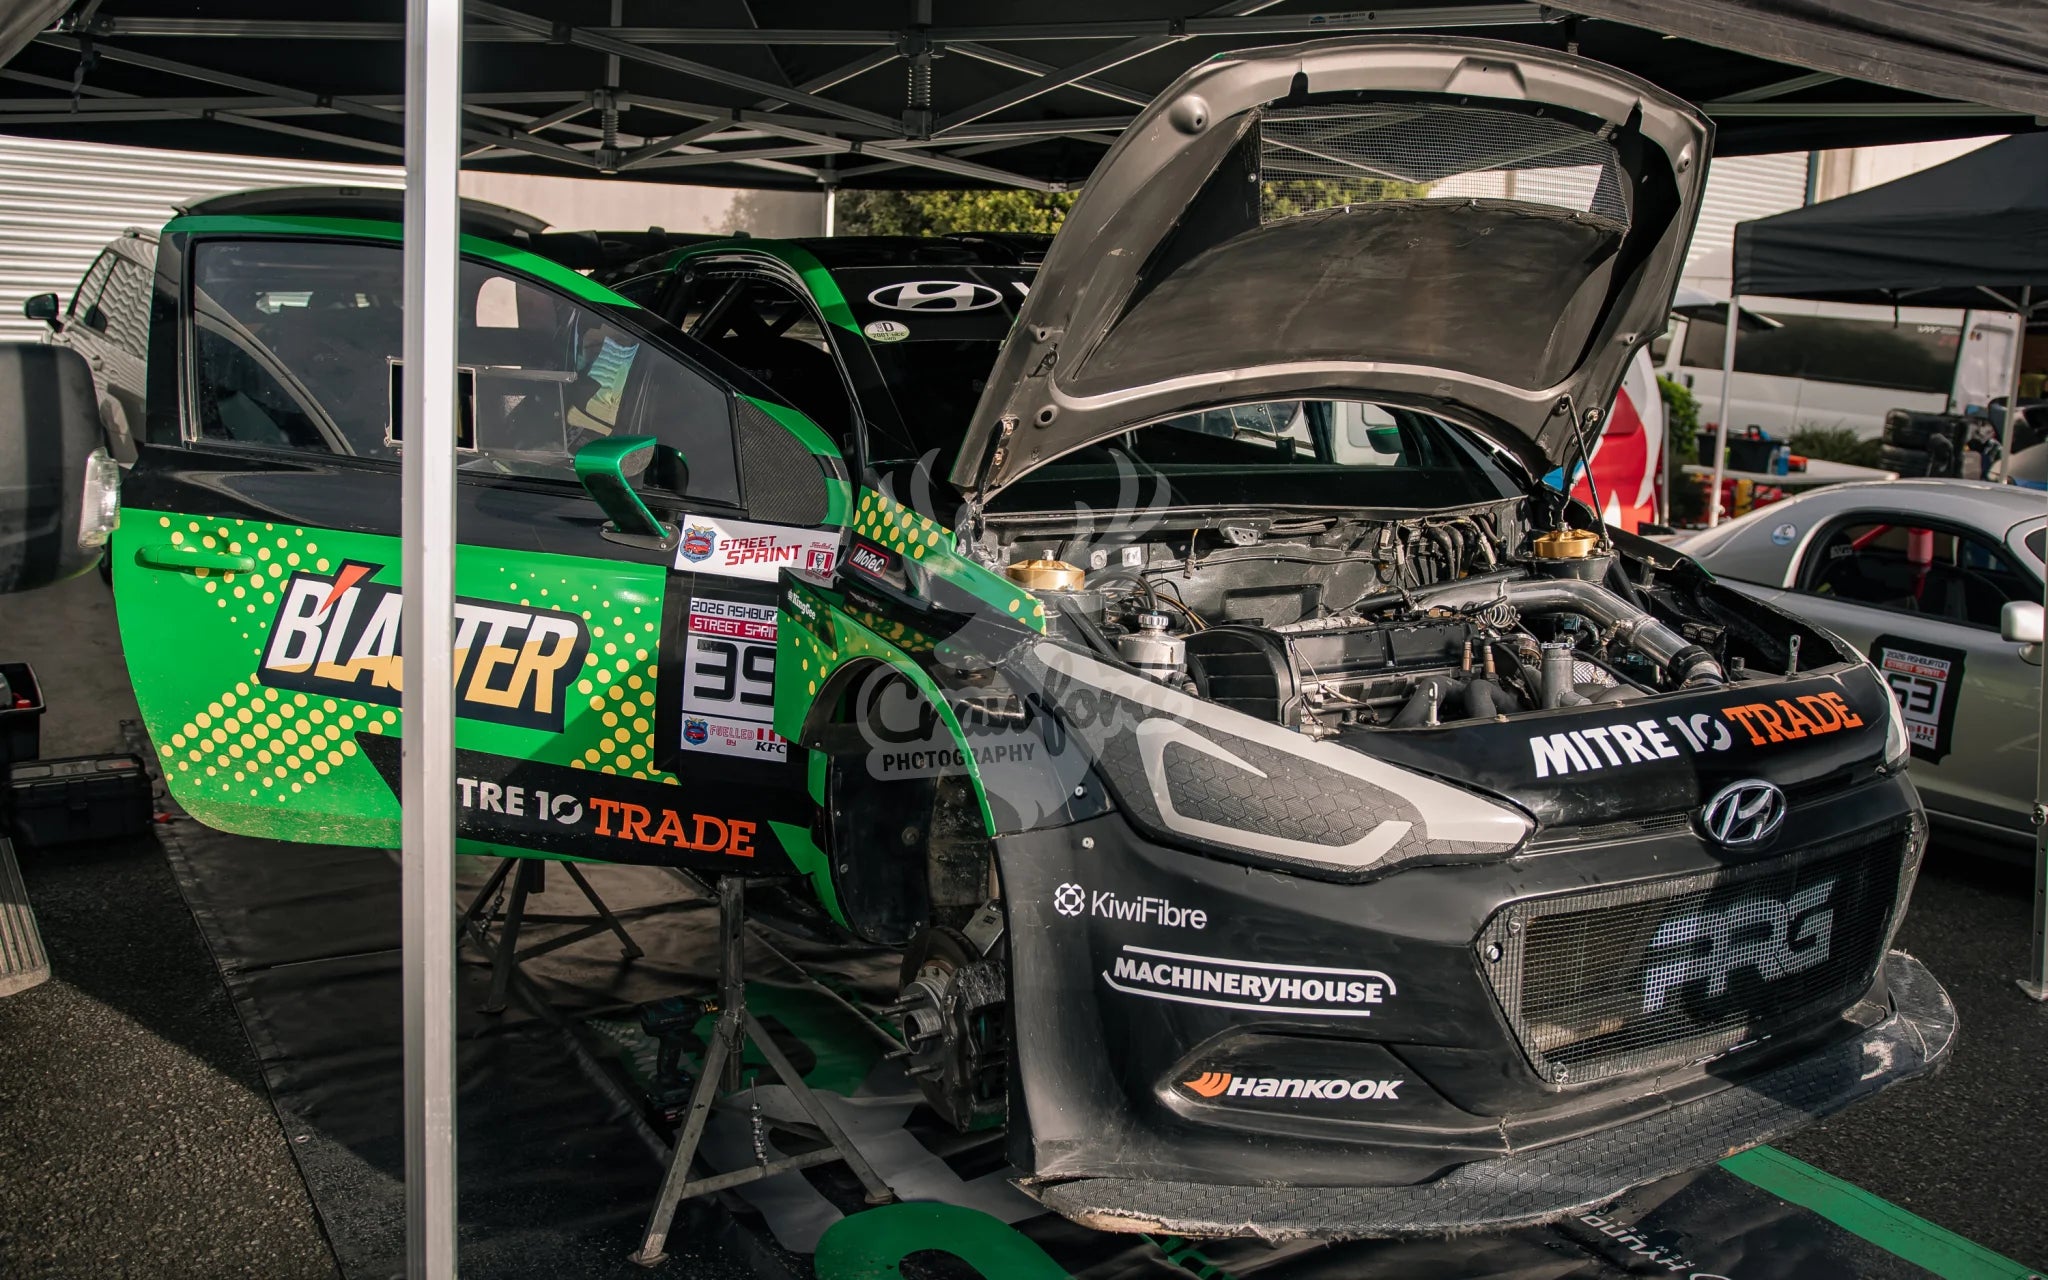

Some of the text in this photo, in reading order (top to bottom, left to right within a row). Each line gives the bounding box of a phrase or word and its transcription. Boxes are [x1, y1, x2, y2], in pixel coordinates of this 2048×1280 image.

[719, 536, 777, 551] STREET
[725, 544, 802, 566] SPRINT
[853, 548, 885, 572] MoTeC
[691, 601, 725, 616] 2026
[792, 592, 816, 620] KingGee
[694, 617, 740, 634] STREET
[694, 639, 778, 706] 39
[709, 725, 787, 754] FUELLED KFC
[726, 739, 737, 747] BY
[1528, 691, 1864, 779] MITRE 10 TRADE
[1916, 733, 1933, 742] KFC
[456, 778, 757, 858] TRE 10 TRADE
[1091, 889, 1208, 931] KiwiFibre
[1113, 957, 1383, 1004] MACHINERYHOUSE
[1576, 1212, 1687, 1272] HYUND
